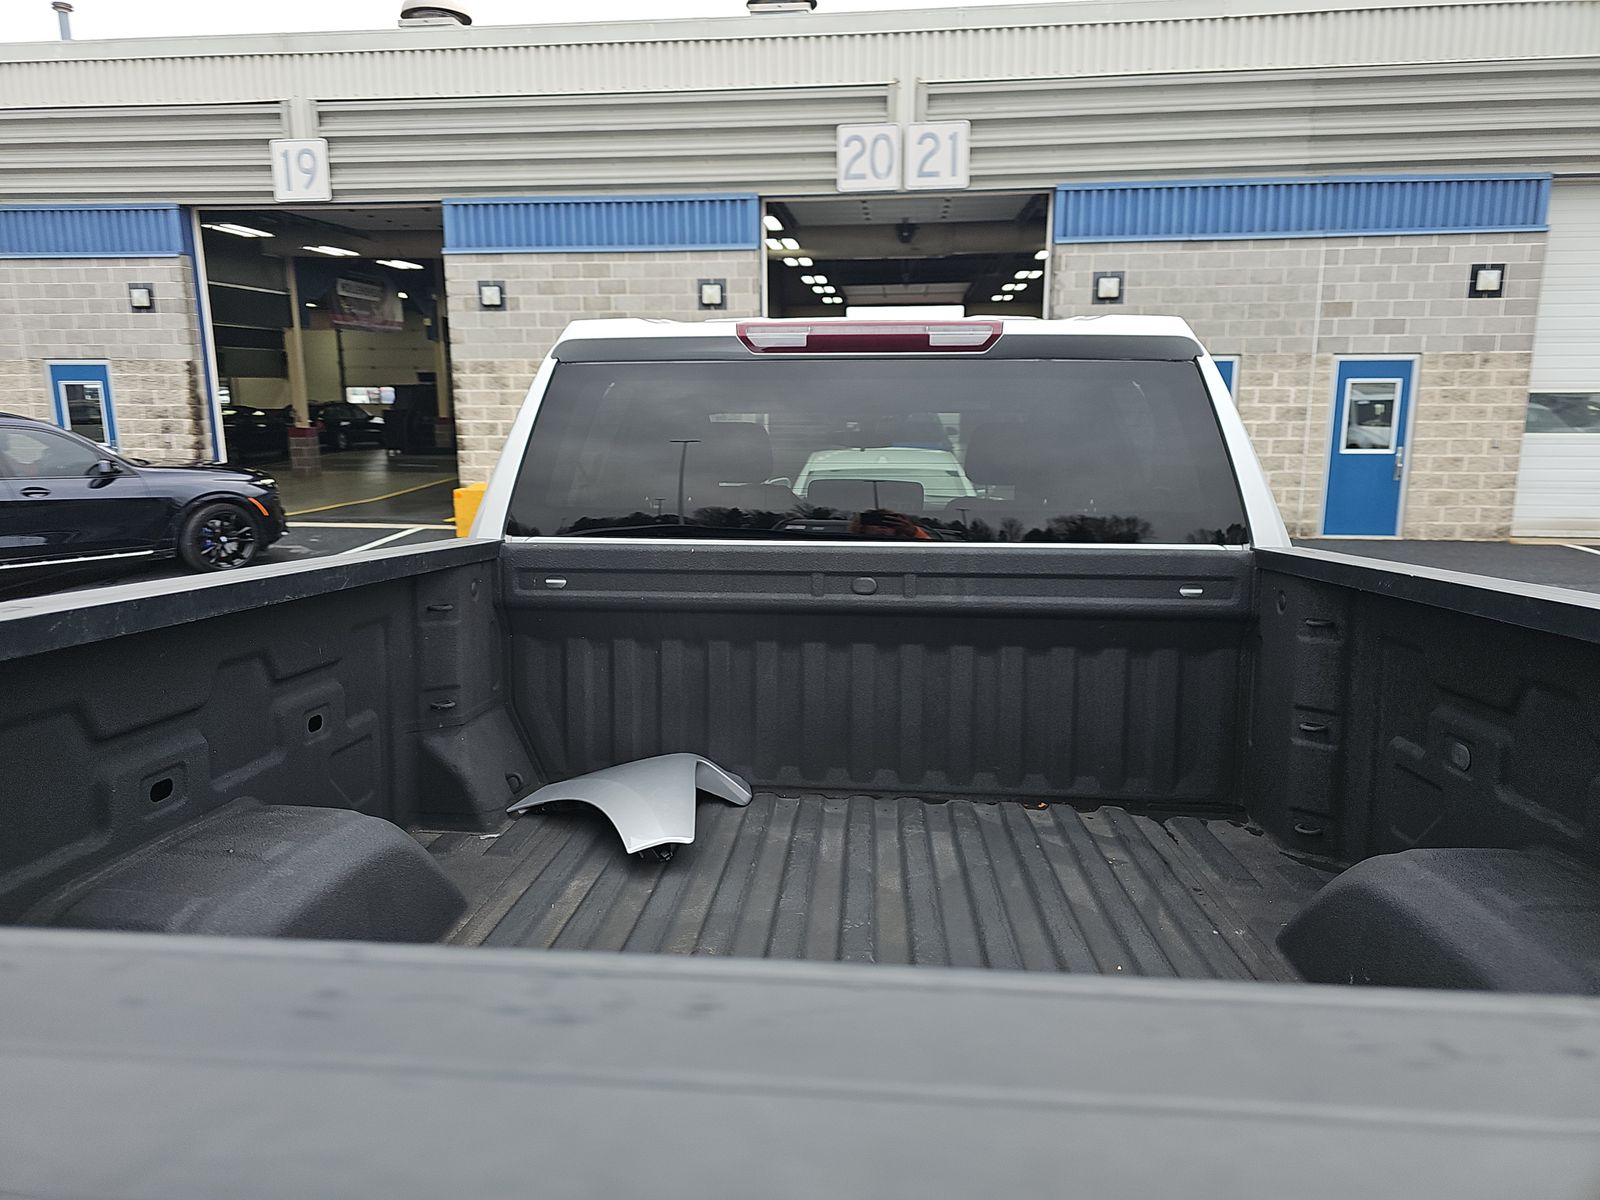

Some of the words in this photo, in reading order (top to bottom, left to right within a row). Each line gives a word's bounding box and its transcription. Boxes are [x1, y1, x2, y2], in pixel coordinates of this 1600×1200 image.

[281, 148, 317, 192] 19
[843, 132, 895, 181] 20
[916, 131, 960, 178] 21
